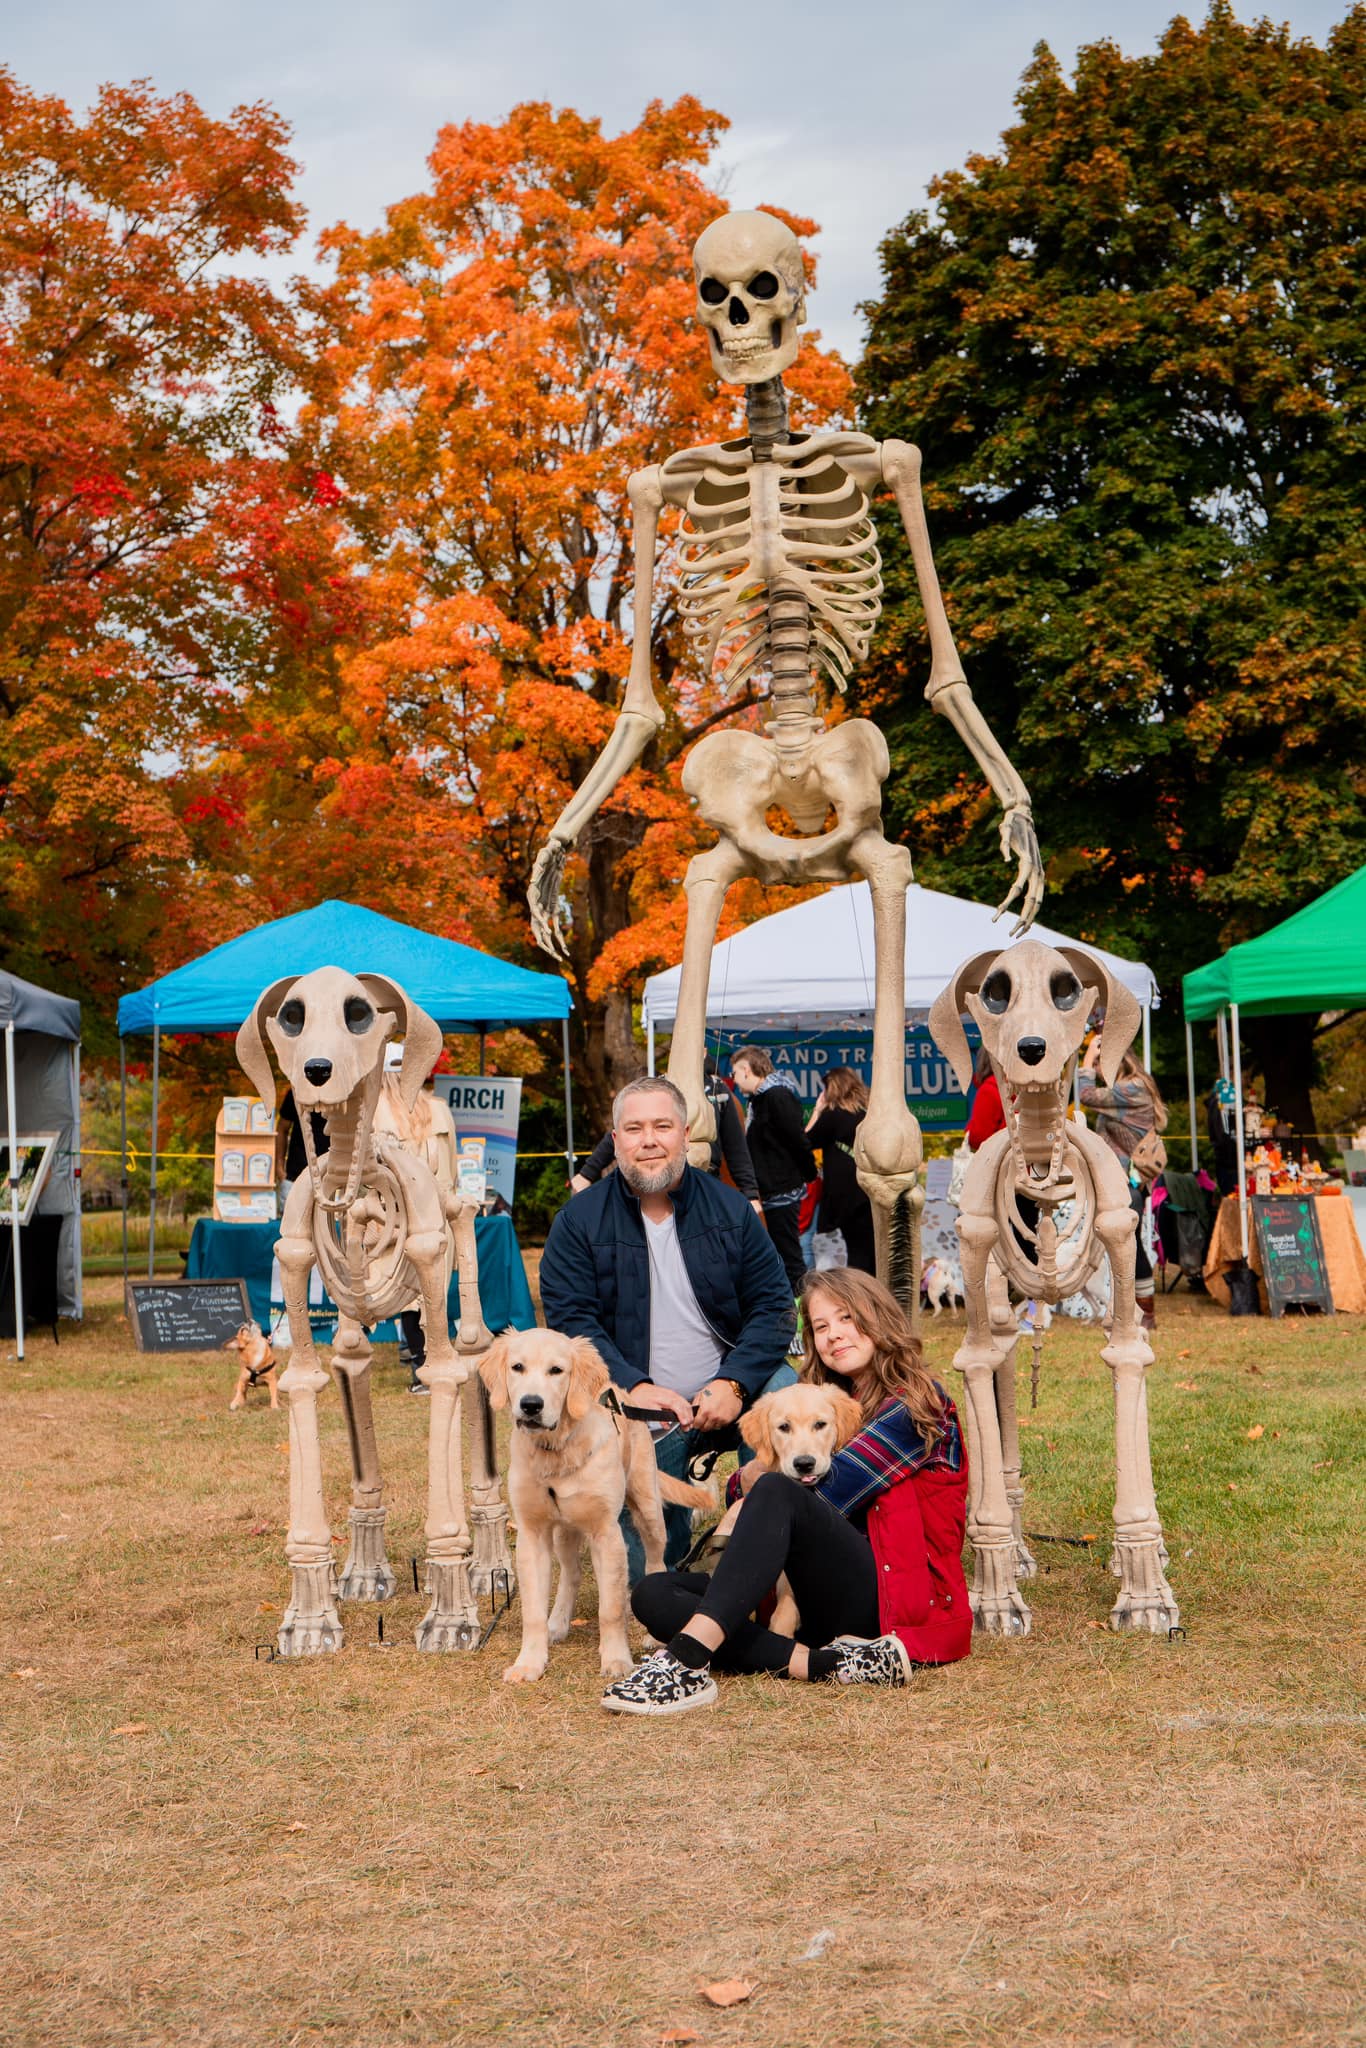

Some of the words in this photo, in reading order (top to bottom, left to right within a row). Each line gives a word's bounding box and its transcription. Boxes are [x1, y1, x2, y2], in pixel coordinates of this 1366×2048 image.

[761, 1048, 828, 1065] RAND
[905, 1063, 962, 1095] LUB
[449, 1087, 504, 1110] ARCH
[909, 1105, 947, 1118] ichigan
[308, 1309, 338, 1317] deliciou
